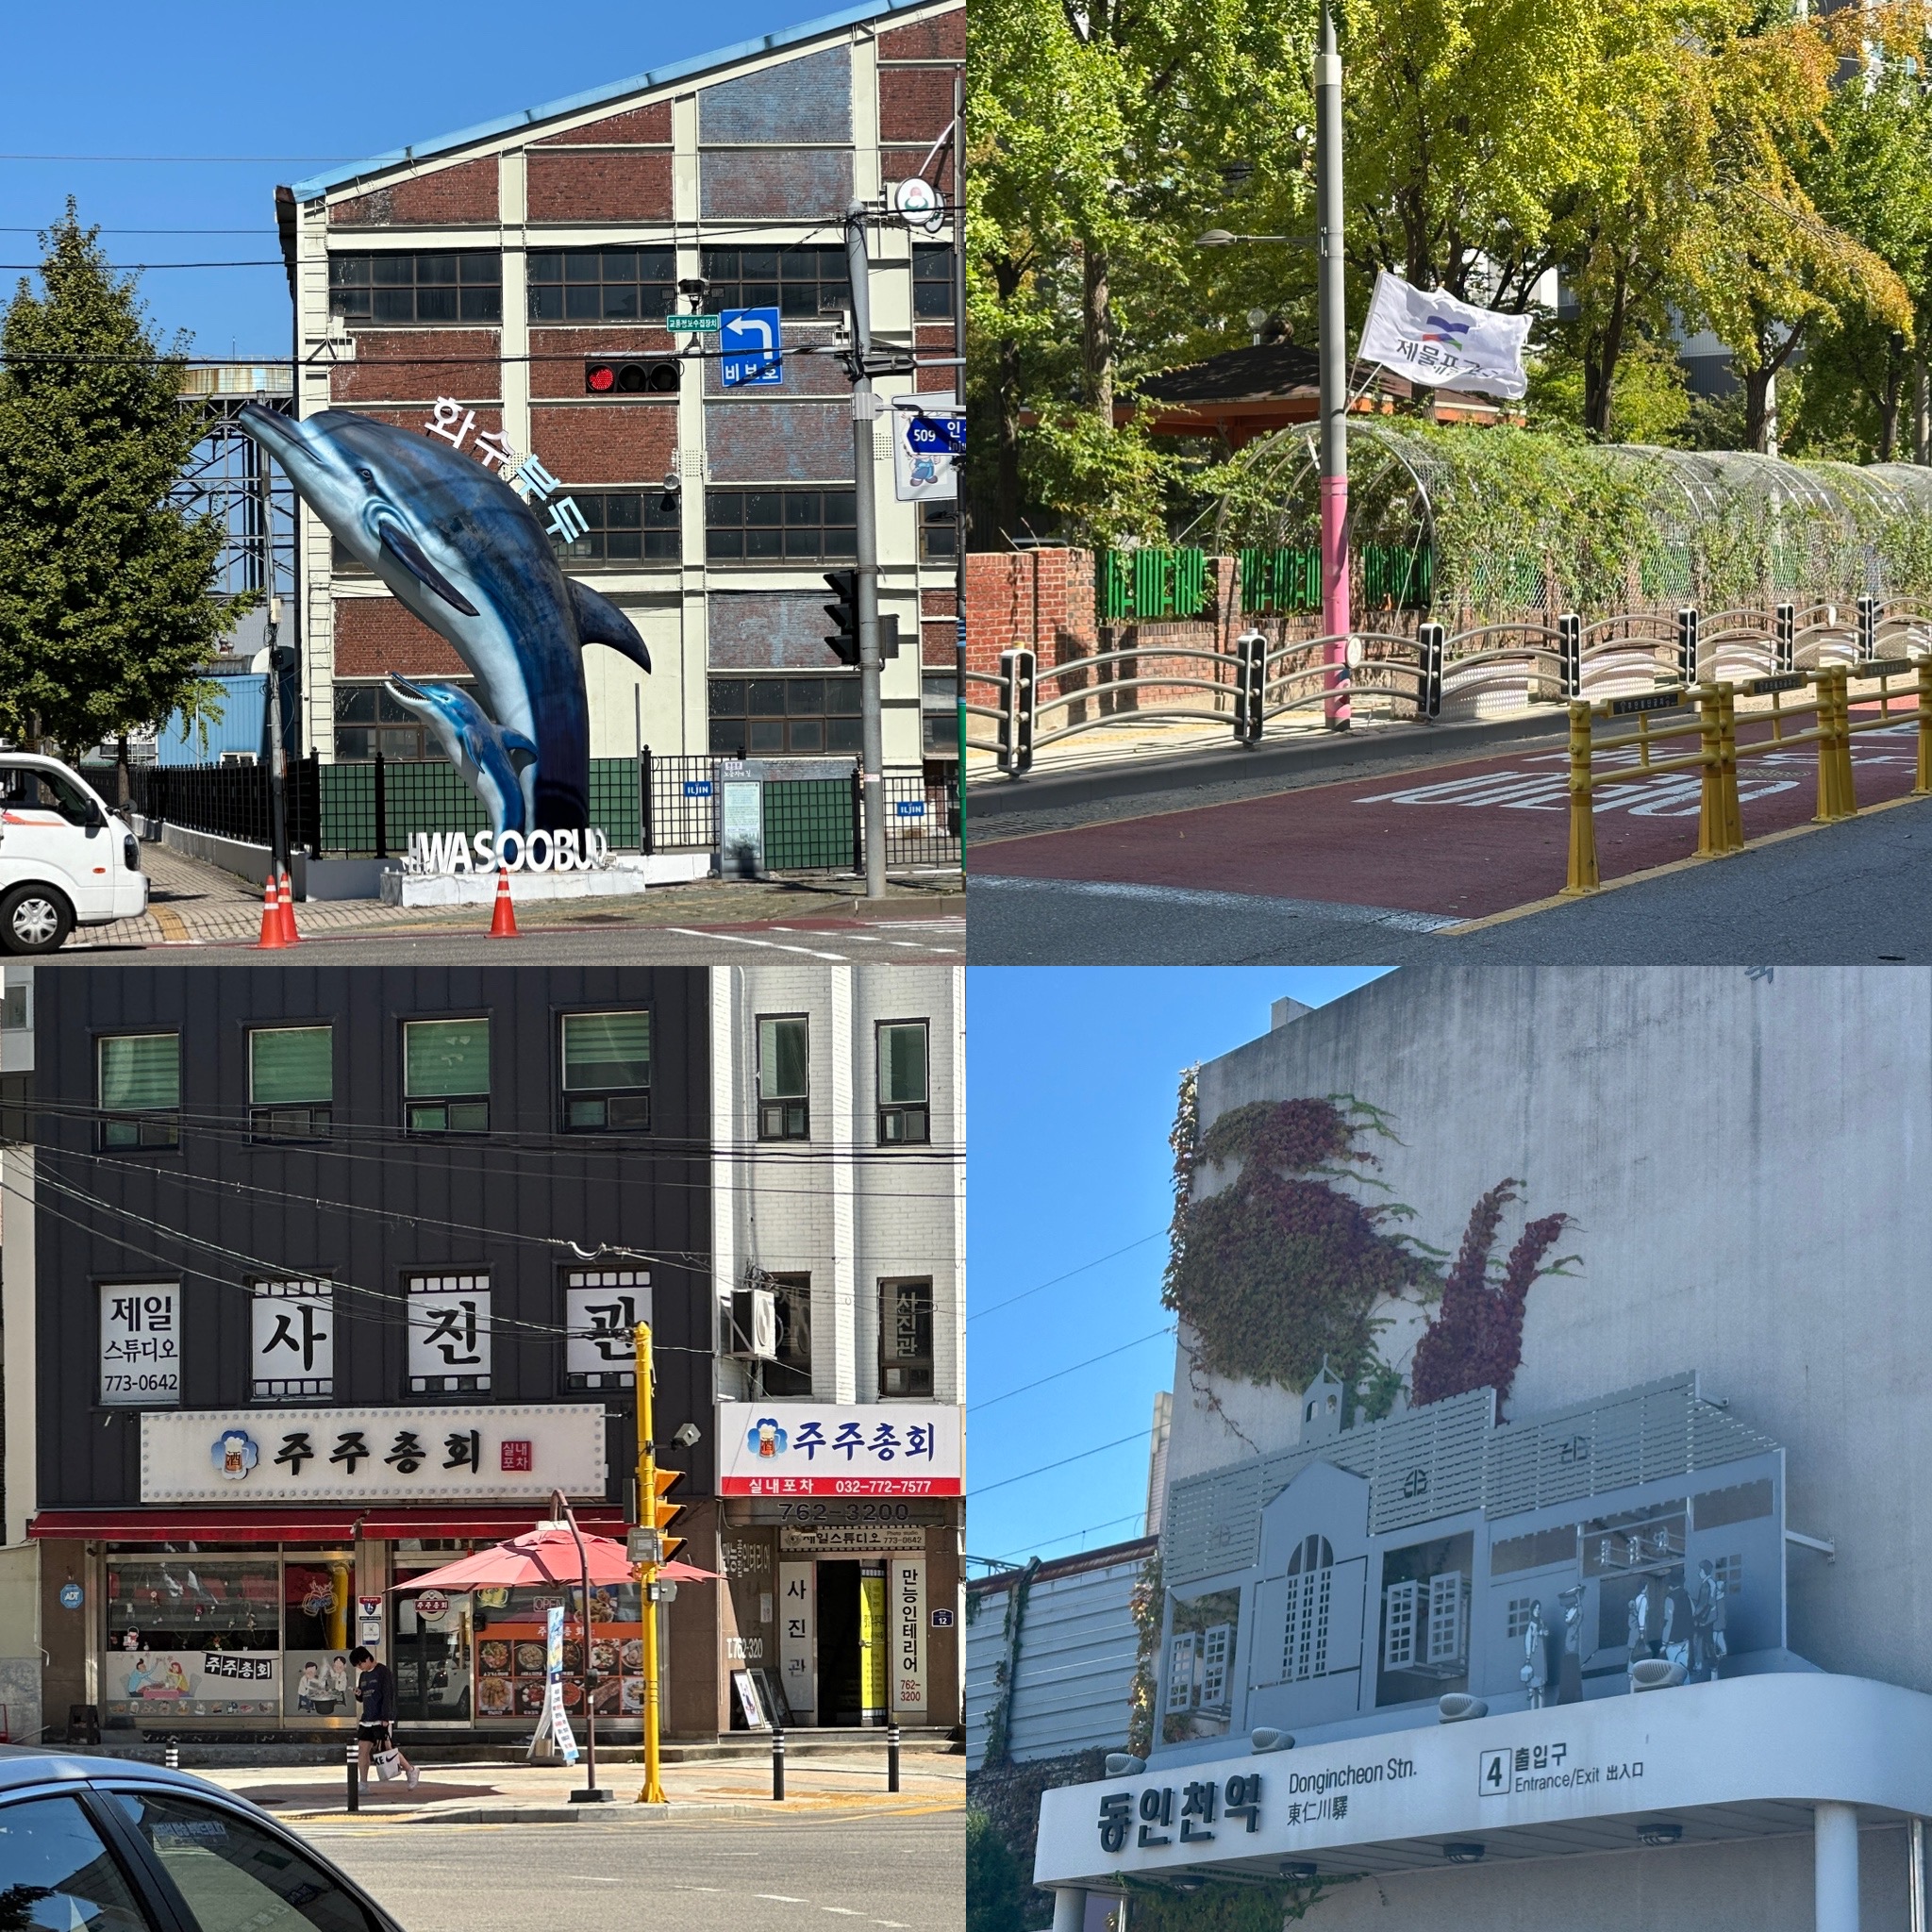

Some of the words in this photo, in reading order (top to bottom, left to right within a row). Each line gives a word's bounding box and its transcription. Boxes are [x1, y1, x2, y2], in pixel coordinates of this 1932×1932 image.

[668, 320, 717, 328] 교통정보수집장치
[725, 360, 779, 381] 비보호
[913, 428, 936, 442] 509
[946, 421, 966, 439] 인
[425, 396, 590, 543] 화수부두
[687, 786, 708, 795] ILJIN
[900, 806, 922, 814] ILJIN
[110, 1296, 172, 1332] 제일
[897, 1291, 918, 1358] 사진관
[262, 1306, 327, 1372] 사
[424, 1300, 481, 1365] 진
[584, 1296, 638, 1361] 관
[104, 1338, 178, 1362] 스튜디오
[105, 1374, 177, 1391] 773-0642
[274, 1429, 480, 1475] 주주총회
[792, 1422, 935, 1462] 주주총회
[749, 1478, 814, 1494] 실내포차
[836, 1480, 932, 1493] 032-772-7577
[778, 1503, 909, 1522] 762-3200
[803, 1532, 881, 1544] 제일스튜디오
[64, 1591, 79, 1601] ADT
[788, 1579, 807, 1677] 사진관
[902, 1569, 918, 1673] 만능인테리어
[206, 1657, 271, 1678] 주주총회
[900, 1680, 921, 1690] 762-
[900, 1690, 921, 1702] 3200
[1515, 1742, 1568, 1773] 출입구
[1289, 1761, 1383, 1795] Dongincheon
[1387, 1757, 1417, 1783] Stn.
[1487, 1757, 1503, 1788] 4
[1515, 1767, 1600, 1793] Entrance/Exit
[1606, 1762, 1643, 1781] 出入口
[1097, 1774, 1262, 1853] 동인천역
[1287, 1795, 1349, 1826] 東仁川驛
